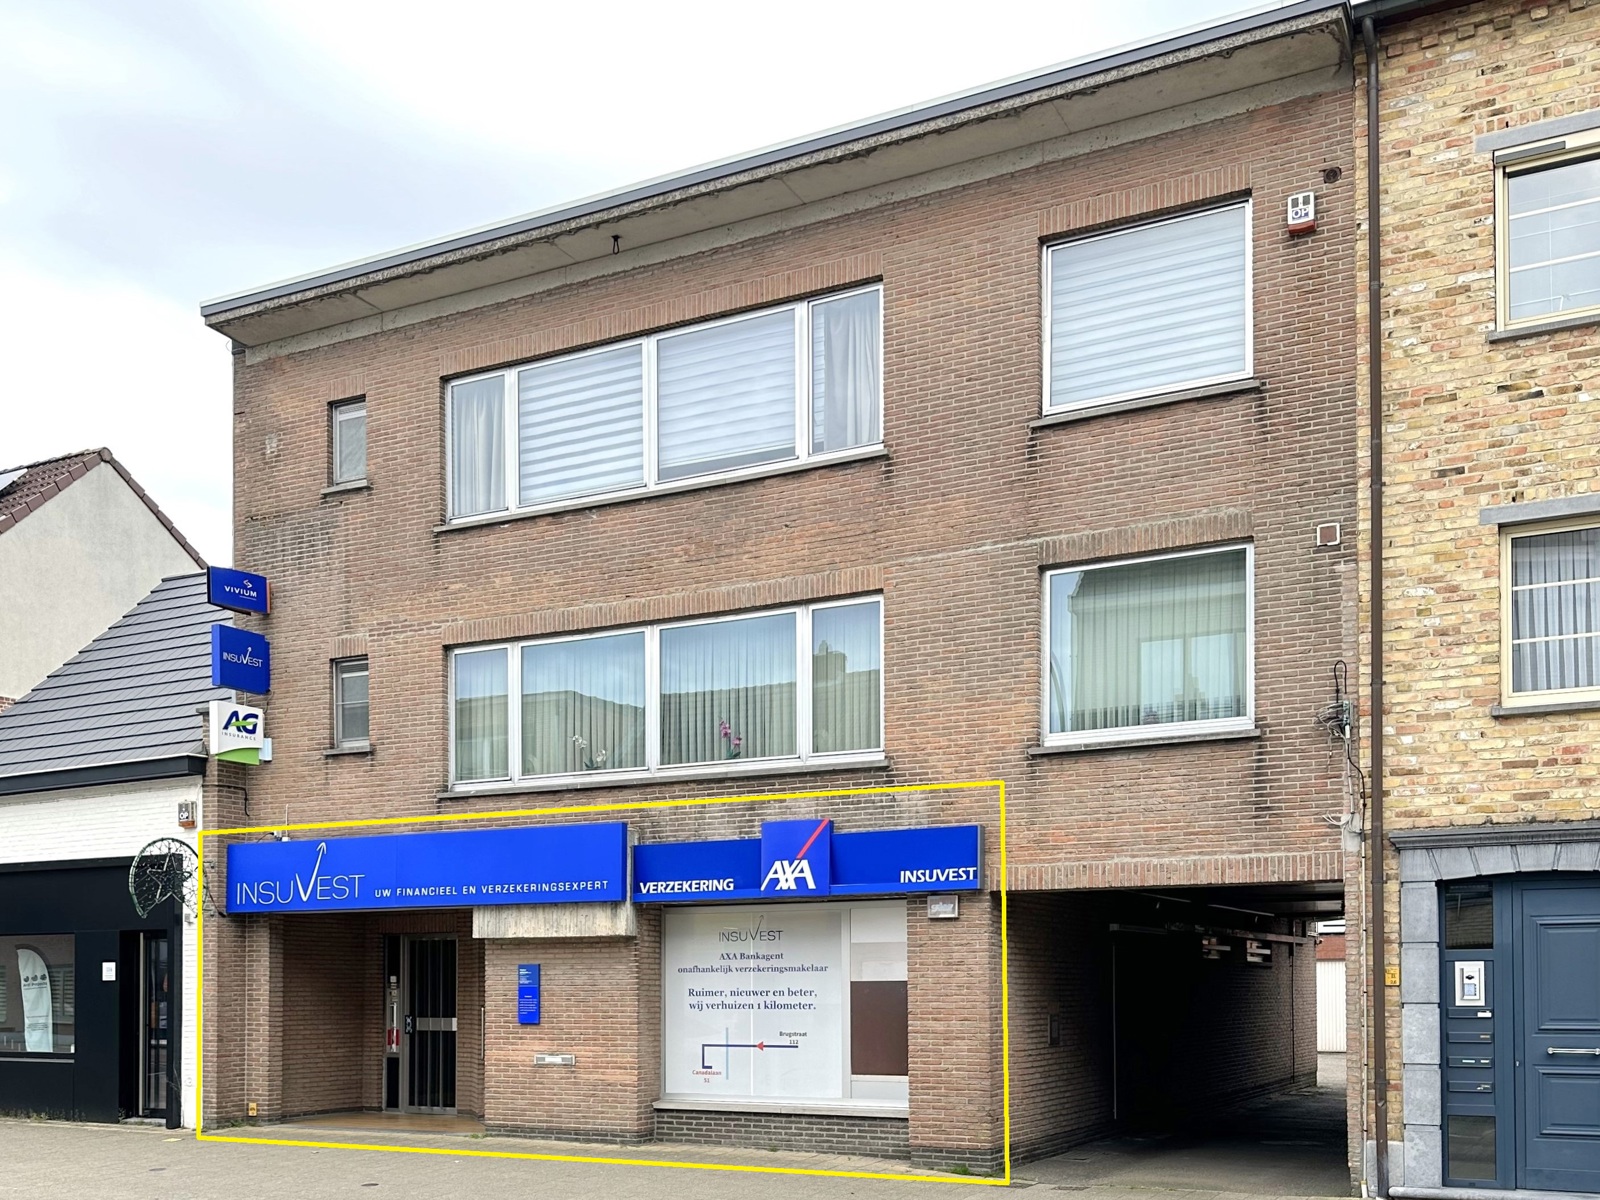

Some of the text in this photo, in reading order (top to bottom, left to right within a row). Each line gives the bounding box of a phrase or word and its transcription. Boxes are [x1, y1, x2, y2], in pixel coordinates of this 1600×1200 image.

[224, 585, 257, 598] VIVIUM
[223, 647, 263, 668] INSUVEST
[222, 710, 259, 735] AG
[221, 731, 257, 741] INSURANCE
[236, 850, 365, 905] INSUVEST
[760, 859, 817, 891] AXA
[900, 867, 977, 884] INSUVEST
[374, 880, 609, 898] UW FINANCIEEL EN VERZEKERINGSEXPERT
[639, 878, 735, 895] VERZEKERING
[718, 921, 784, 942] INSUVEST
[719, 952, 784, 962] AXA Bankagent
[677, 963, 829, 974] onafhankelijk verzekeringsmakelaar
[688, 987, 818, 998] Ruimer, nieuwer en beter,
[688, 1000, 704, 1011] wij
[705, 1000, 754, 1010] verhuizen
[763, 1000, 817, 1010] kilometer.
